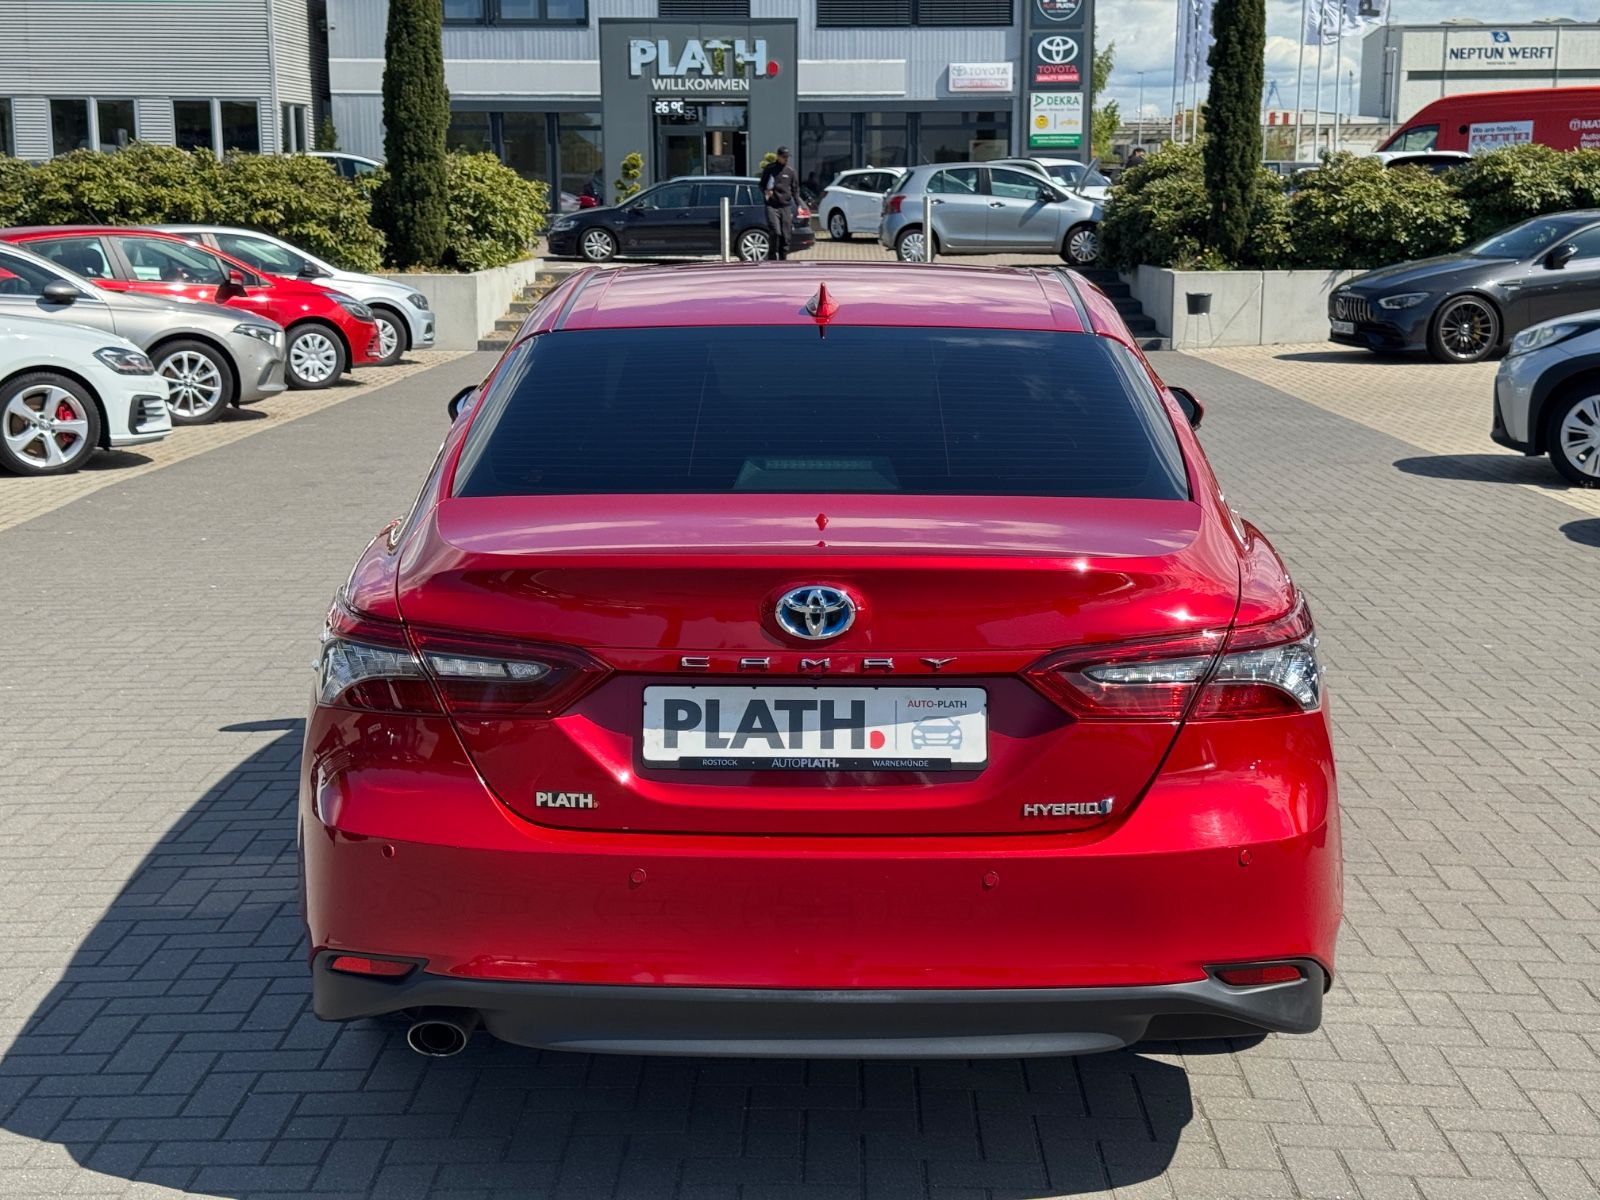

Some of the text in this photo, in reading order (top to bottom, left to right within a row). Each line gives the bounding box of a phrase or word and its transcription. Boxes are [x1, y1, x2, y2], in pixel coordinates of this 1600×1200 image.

[1449, 46, 1554, 59] NEPTUN WERFT
[969, 67, 1008, 76] TOYOTA
[1037, 65, 1078, 73] TOYOTA
[651, 78, 750, 91] WILLKOMMEN
[1046, 95, 1080, 106] DEKRA
[655, 101, 669, 114] 26
[681, 656, 957, 669] CAMRY
[907, 699, 967, 708] AUTO-PLATH
[702, 758, 738, 766] ROSTOCK
[871, 759, 930, 767] WARNEMÜNDE
[1023, 802, 1099, 816] HYBRID
